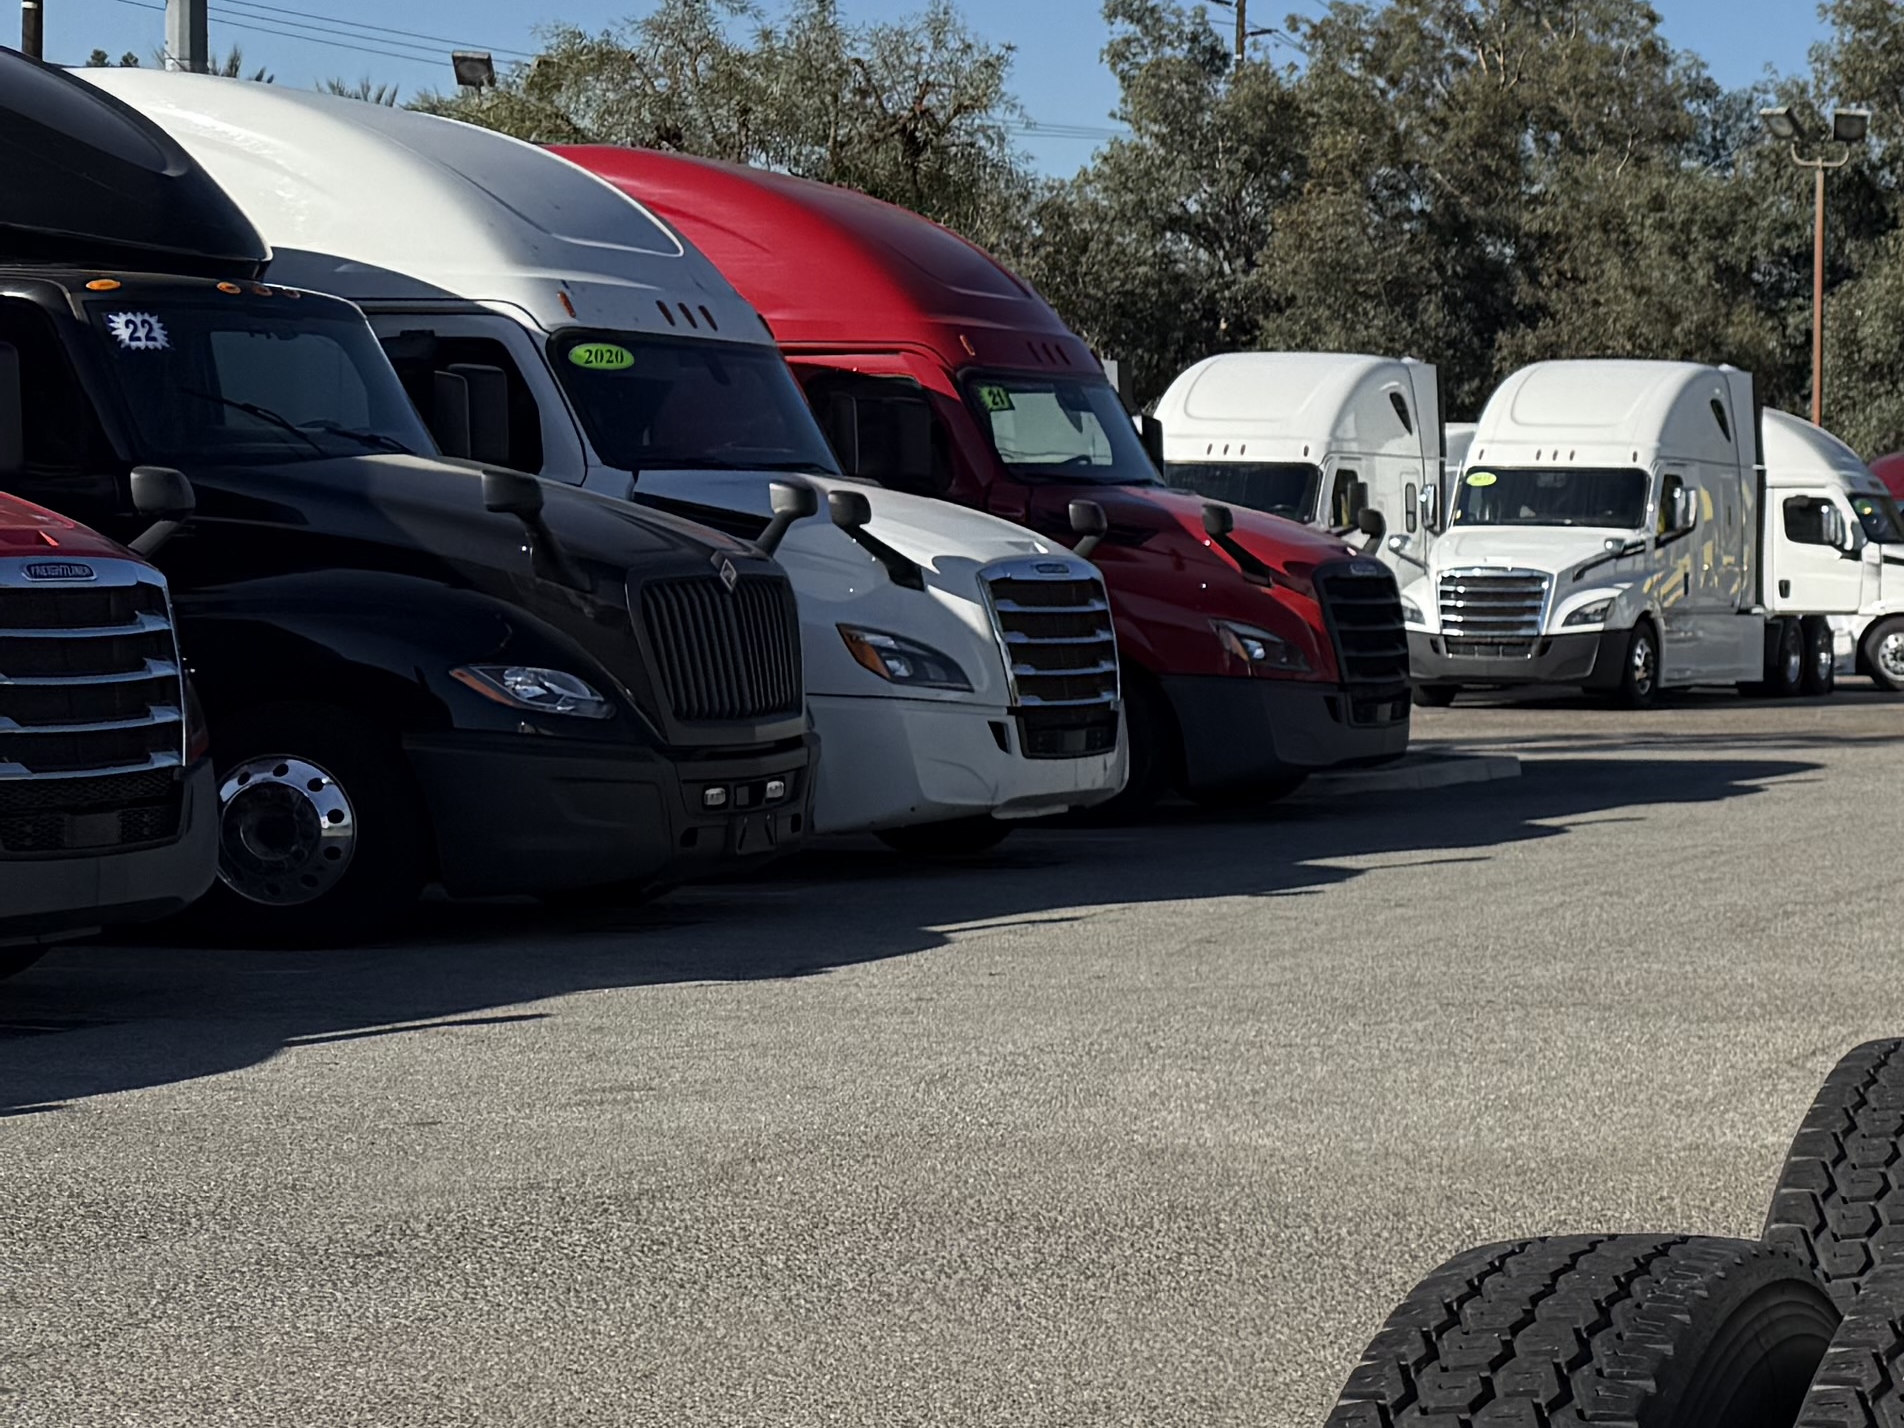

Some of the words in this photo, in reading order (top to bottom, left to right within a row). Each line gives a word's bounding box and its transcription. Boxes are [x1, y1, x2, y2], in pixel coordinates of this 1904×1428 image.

[124, 318, 158, 342] 22
[583, 349, 625, 365] 2020
[987, 388, 1006, 406] 21
